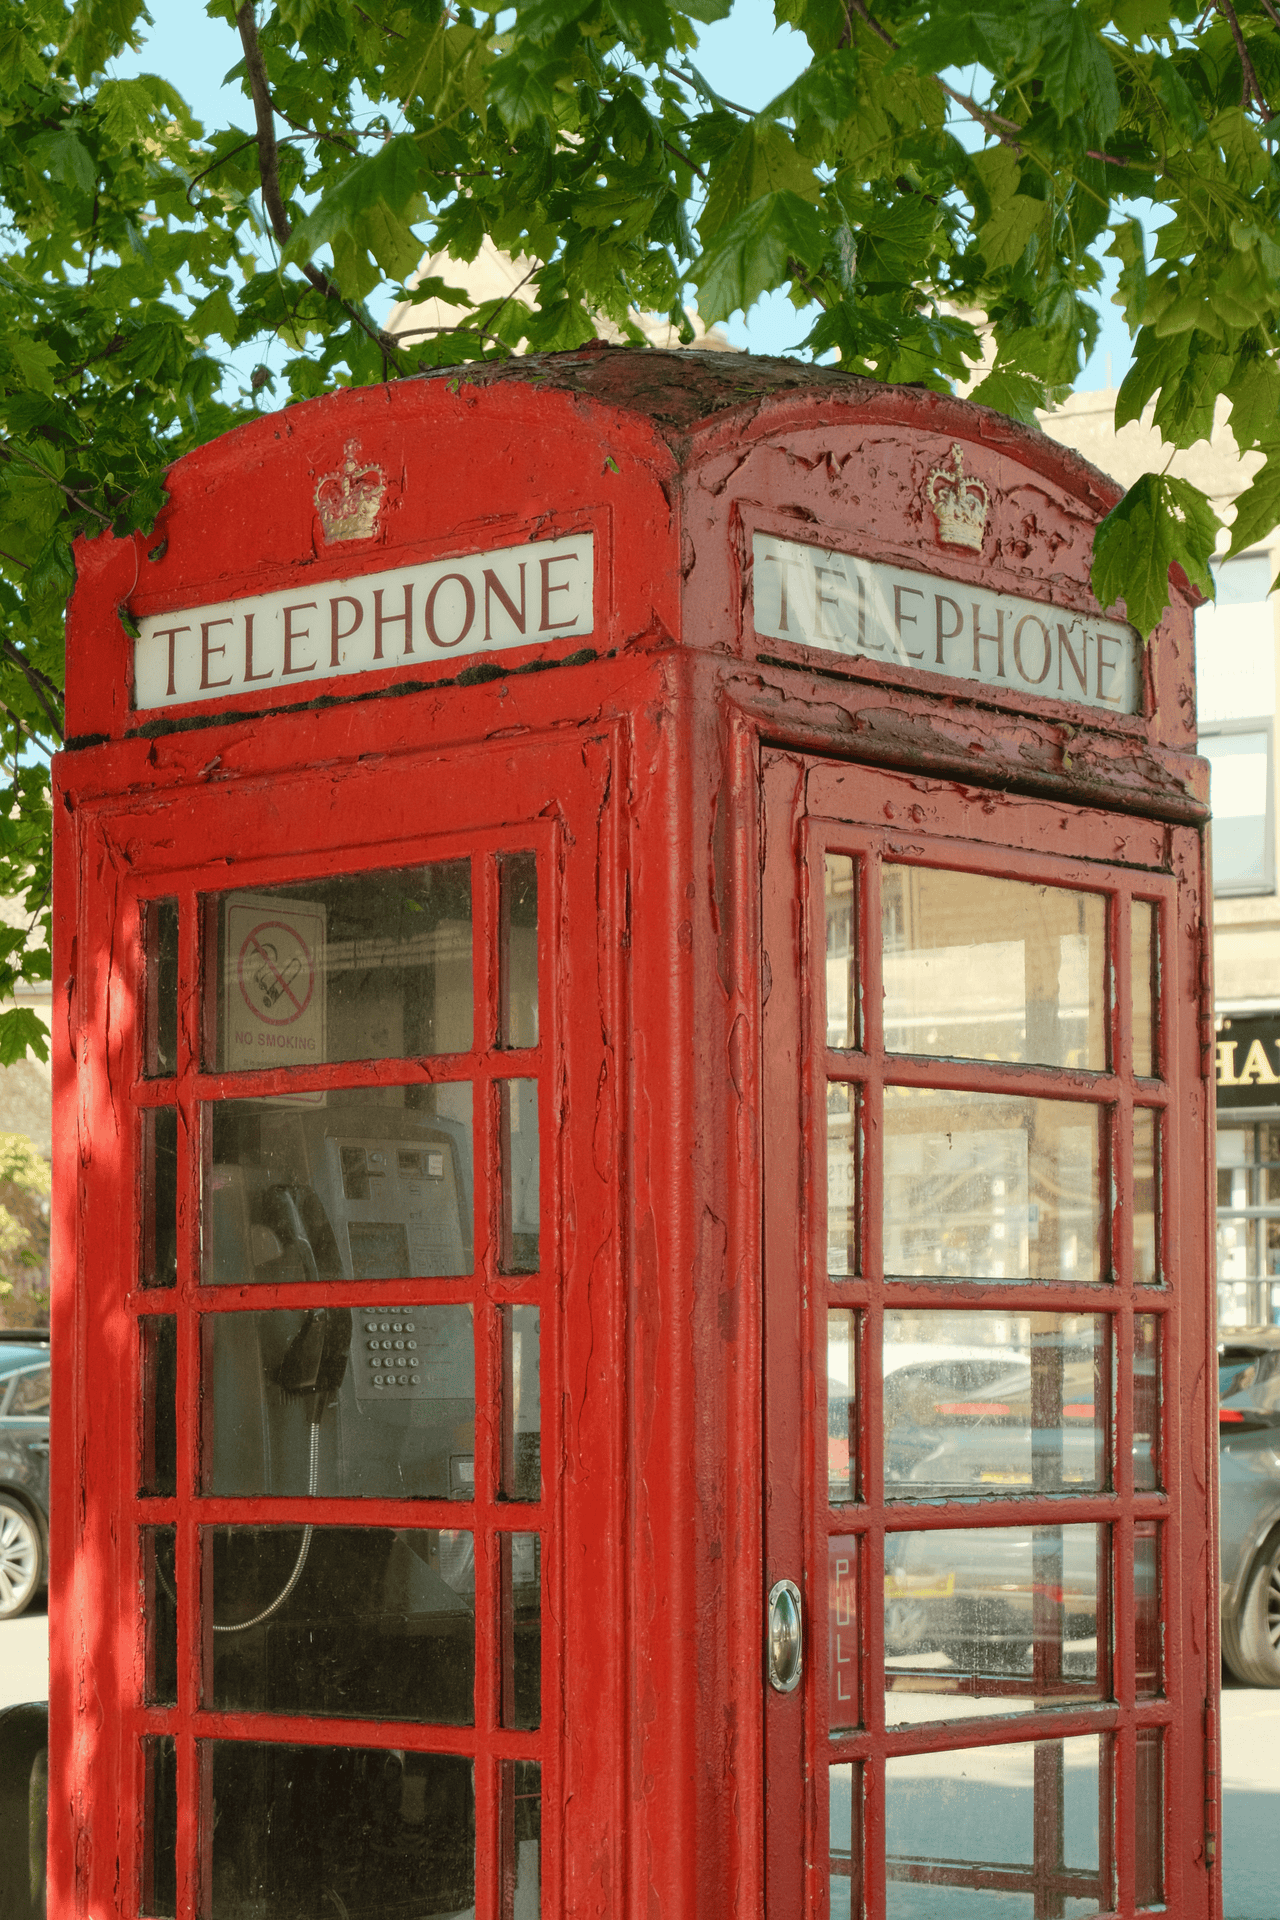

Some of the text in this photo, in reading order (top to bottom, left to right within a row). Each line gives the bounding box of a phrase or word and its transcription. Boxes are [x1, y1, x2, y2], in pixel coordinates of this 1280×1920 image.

[152, 553, 580, 697] TELEPHONE
[764, 554, 1123, 703] TELEPHONE
[235, 1031, 316, 1051] NO SMOKING
[836, 1559, 851, 1701] PULL
